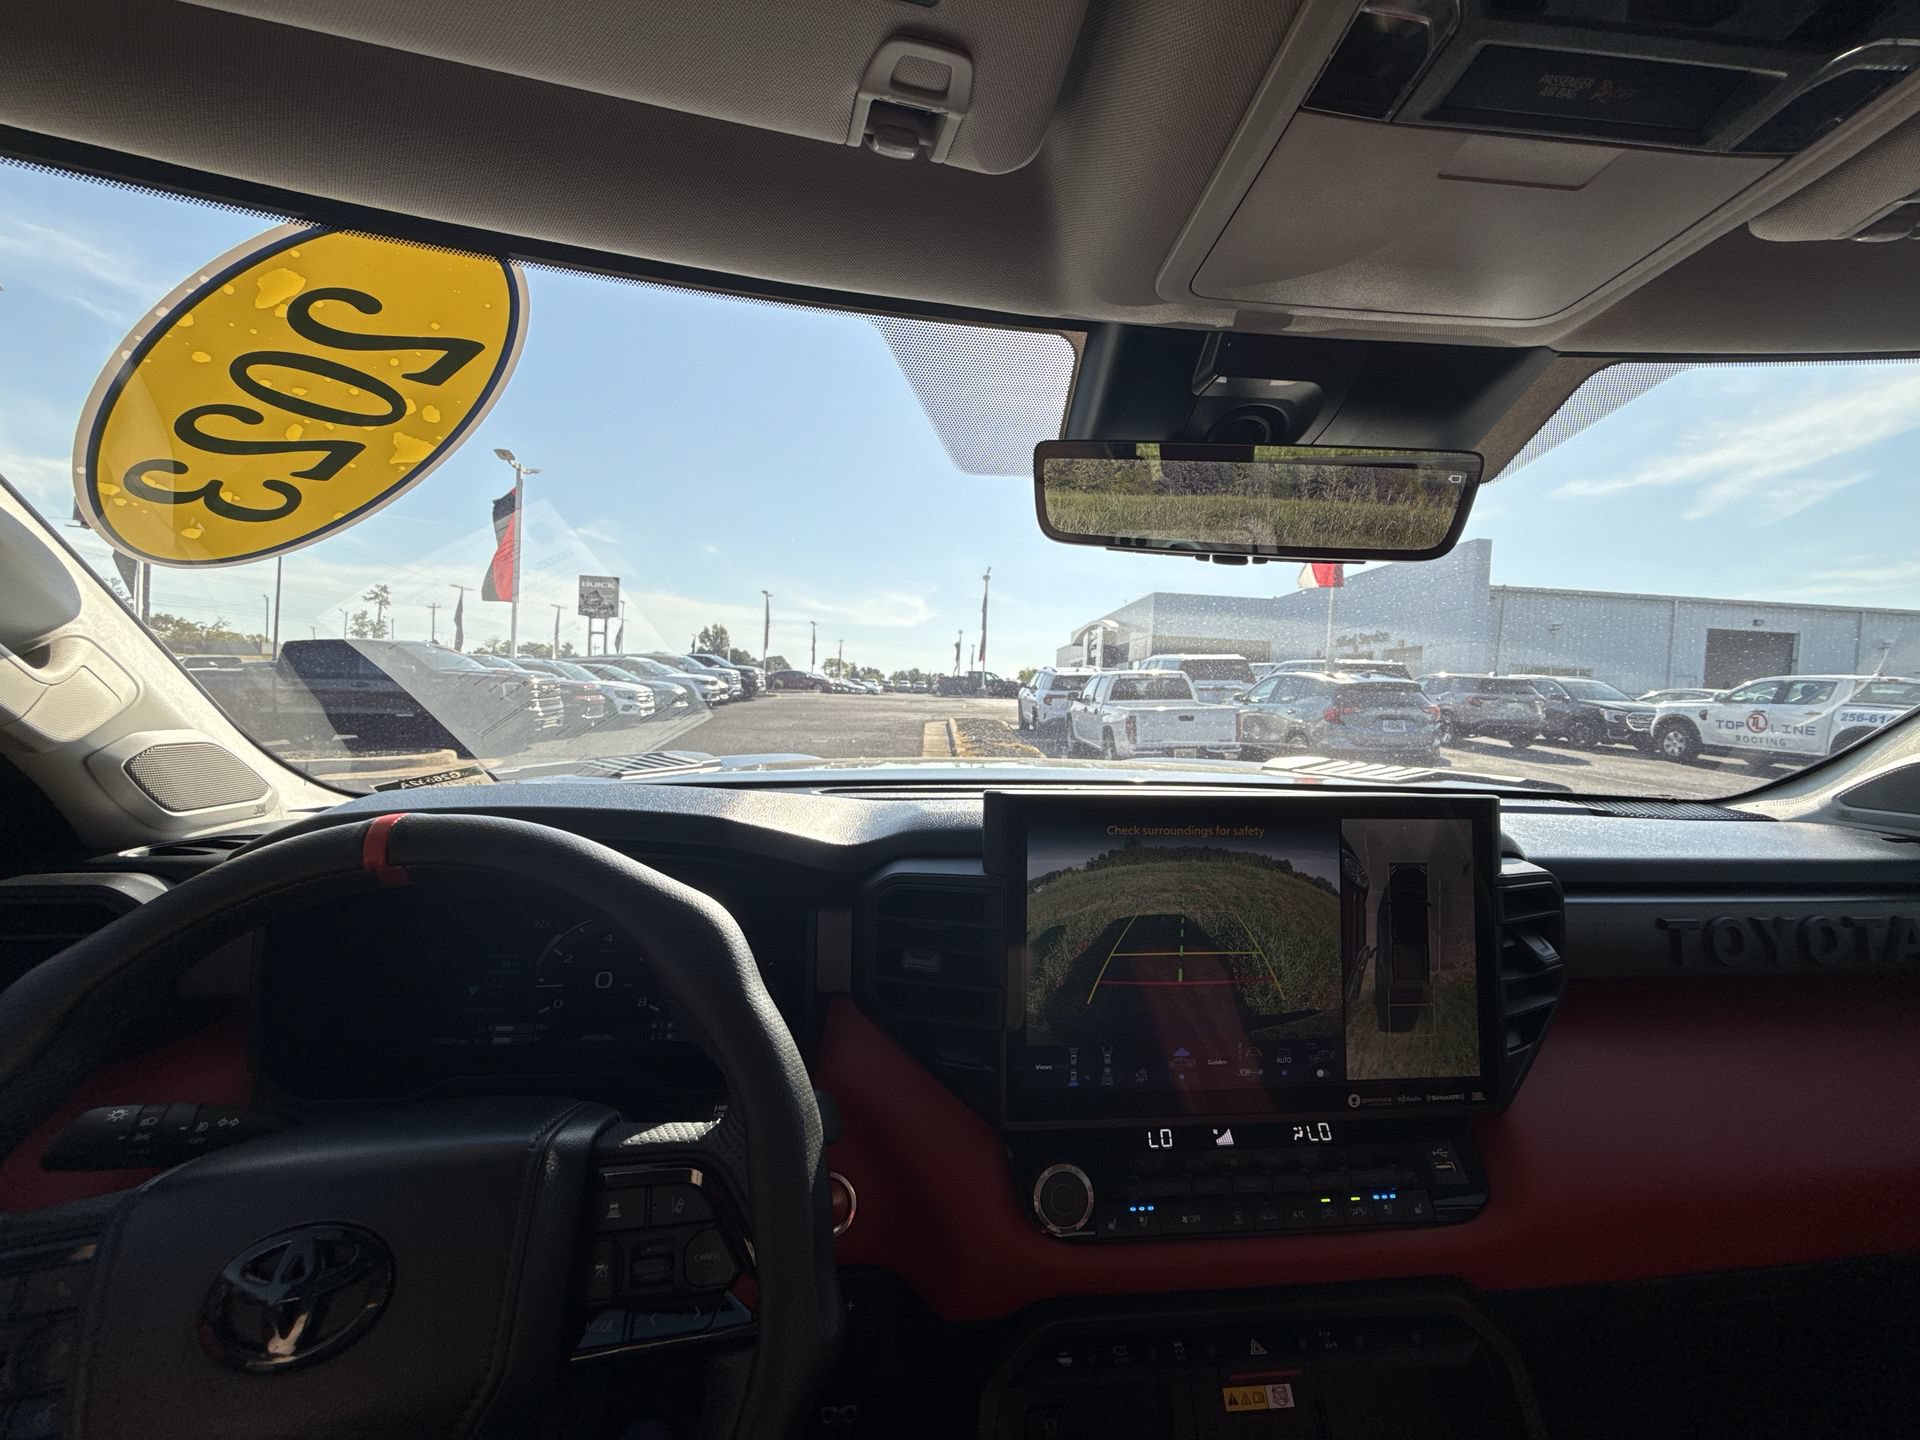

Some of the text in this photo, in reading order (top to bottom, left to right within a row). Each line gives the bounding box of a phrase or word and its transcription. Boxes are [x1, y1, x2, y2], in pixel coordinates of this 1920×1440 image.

[581, 581, 616, 589] BUICK
[1716, 719, 1745, 730] TOP
[1771, 724, 1817, 736] LINE
[1735, 735, 1787, 747] ROOFING
[1106, 825, 1265, 838] Check surroundings for safety
[603, 933, 613, 943] 4
[1656, 915, 1920, 966] TOYOTA
[564, 953, 574, 963] 2
[553, 999, 563, 1009] 0
[638, 997, 648, 1007] 8
[1207, 1058, 1227, 1066] Guides
[1276, 1056, 1292, 1064] AUTO
[1035, 1063, 1052, 1071] Views
[1306, 1122, 1332, 1142] LO
[1148, 1129, 1173, 1148] LO
[1189, 1214, 1201, 1223] OFF
[1292, 1210, 1305, 1219] A/C
